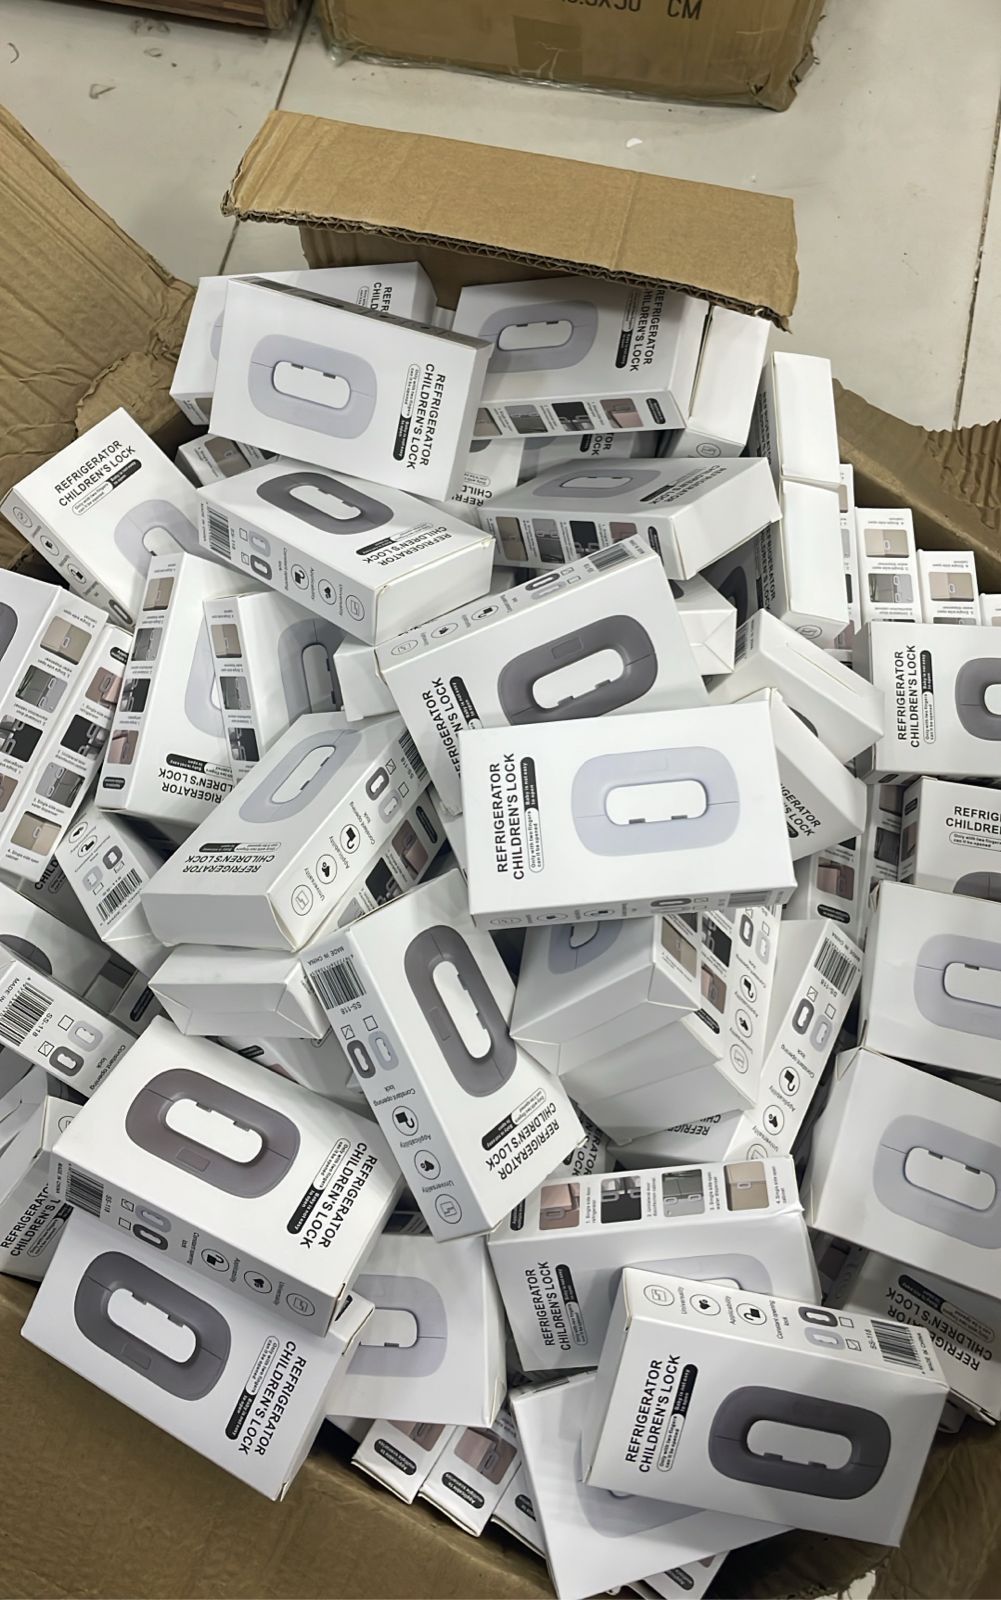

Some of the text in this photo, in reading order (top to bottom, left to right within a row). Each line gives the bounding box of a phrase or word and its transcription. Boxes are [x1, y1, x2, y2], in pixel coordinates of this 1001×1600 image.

[667, 0, 702, 20] CM
[634, 289, 653, 342] HILDREN'S
[642, 289, 665, 366] REFRIGERATOR
[629, 342, 642, 372] LOCK
[406, 362, 434, 469] CHILDREN'S LOCK
[419, 373, 445, 465] REFRIGERATOR
[591, 434, 603, 456] OCK
[53, 439, 122, 493] REFRIGERATOR
[57, 444, 136, 507] CHILDREN'S LOCK
[361, 547, 392, 565] LOCK
[378, 532, 451, 567] REFRIGERATOR
[391, 525, 447, 552] CHILDREN'S
[431, 676, 454, 711] LOCK
[894, 651, 906, 739] REFRIGERATOR
[906, 645, 919, 747] CHILDREN'S LOCK
[421, 689, 467, 778] EFRIGERATOR
[158, 767, 232, 792] LDREN'S LOCK
[161, 782, 222, 804] RIGERATOR
[775, 782, 821, 829] GERATOR
[488, 762, 508, 872] REFRIGERATOR
[502, 753, 524, 879] CHILDREN'S LOCK
[788, 811, 814, 838] LOCK
[945, 817, 998, 834] CHILDRE
[954, 806, 999, 821] REFRIG
[3, 977, 20, 995] MADE
[340, 1000, 363, 1016] SS-118
[31, 1012, 53, 1037] SS-118
[399, 1133, 431, 1148] Applicability
[483, 1101, 558, 1171] CHILDREN'S LOCK
[497, 1118, 561, 1180] REFRIGERATOR
[0, 1182, 54, 1249] REFRIGERAT
[299, 1140, 368, 1249] CHILDREN'S LOCK
[317, 1153, 378, 1249] REFRIGERATOR
[421, 1179, 454, 1194] Universality
[9, 1201, 55, 1258] CHILDREN'S
[525, 1267, 555, 1347] REFRIGERATOR
[537, 1260, 571, 1351] CHILDREN'S LOCK
[883, 1286, 994, 1361] CHILDREN'S LOCK
[237, 1339, 298, 1455] CHILDREN'S LOCK
[254, 1355, 307, 1456] REFRIGERATOR
[624, 1359, 663, 1462] REFRIGERATOR
[638, 1353, 680, 1473] CHILDREN'S LOCK
